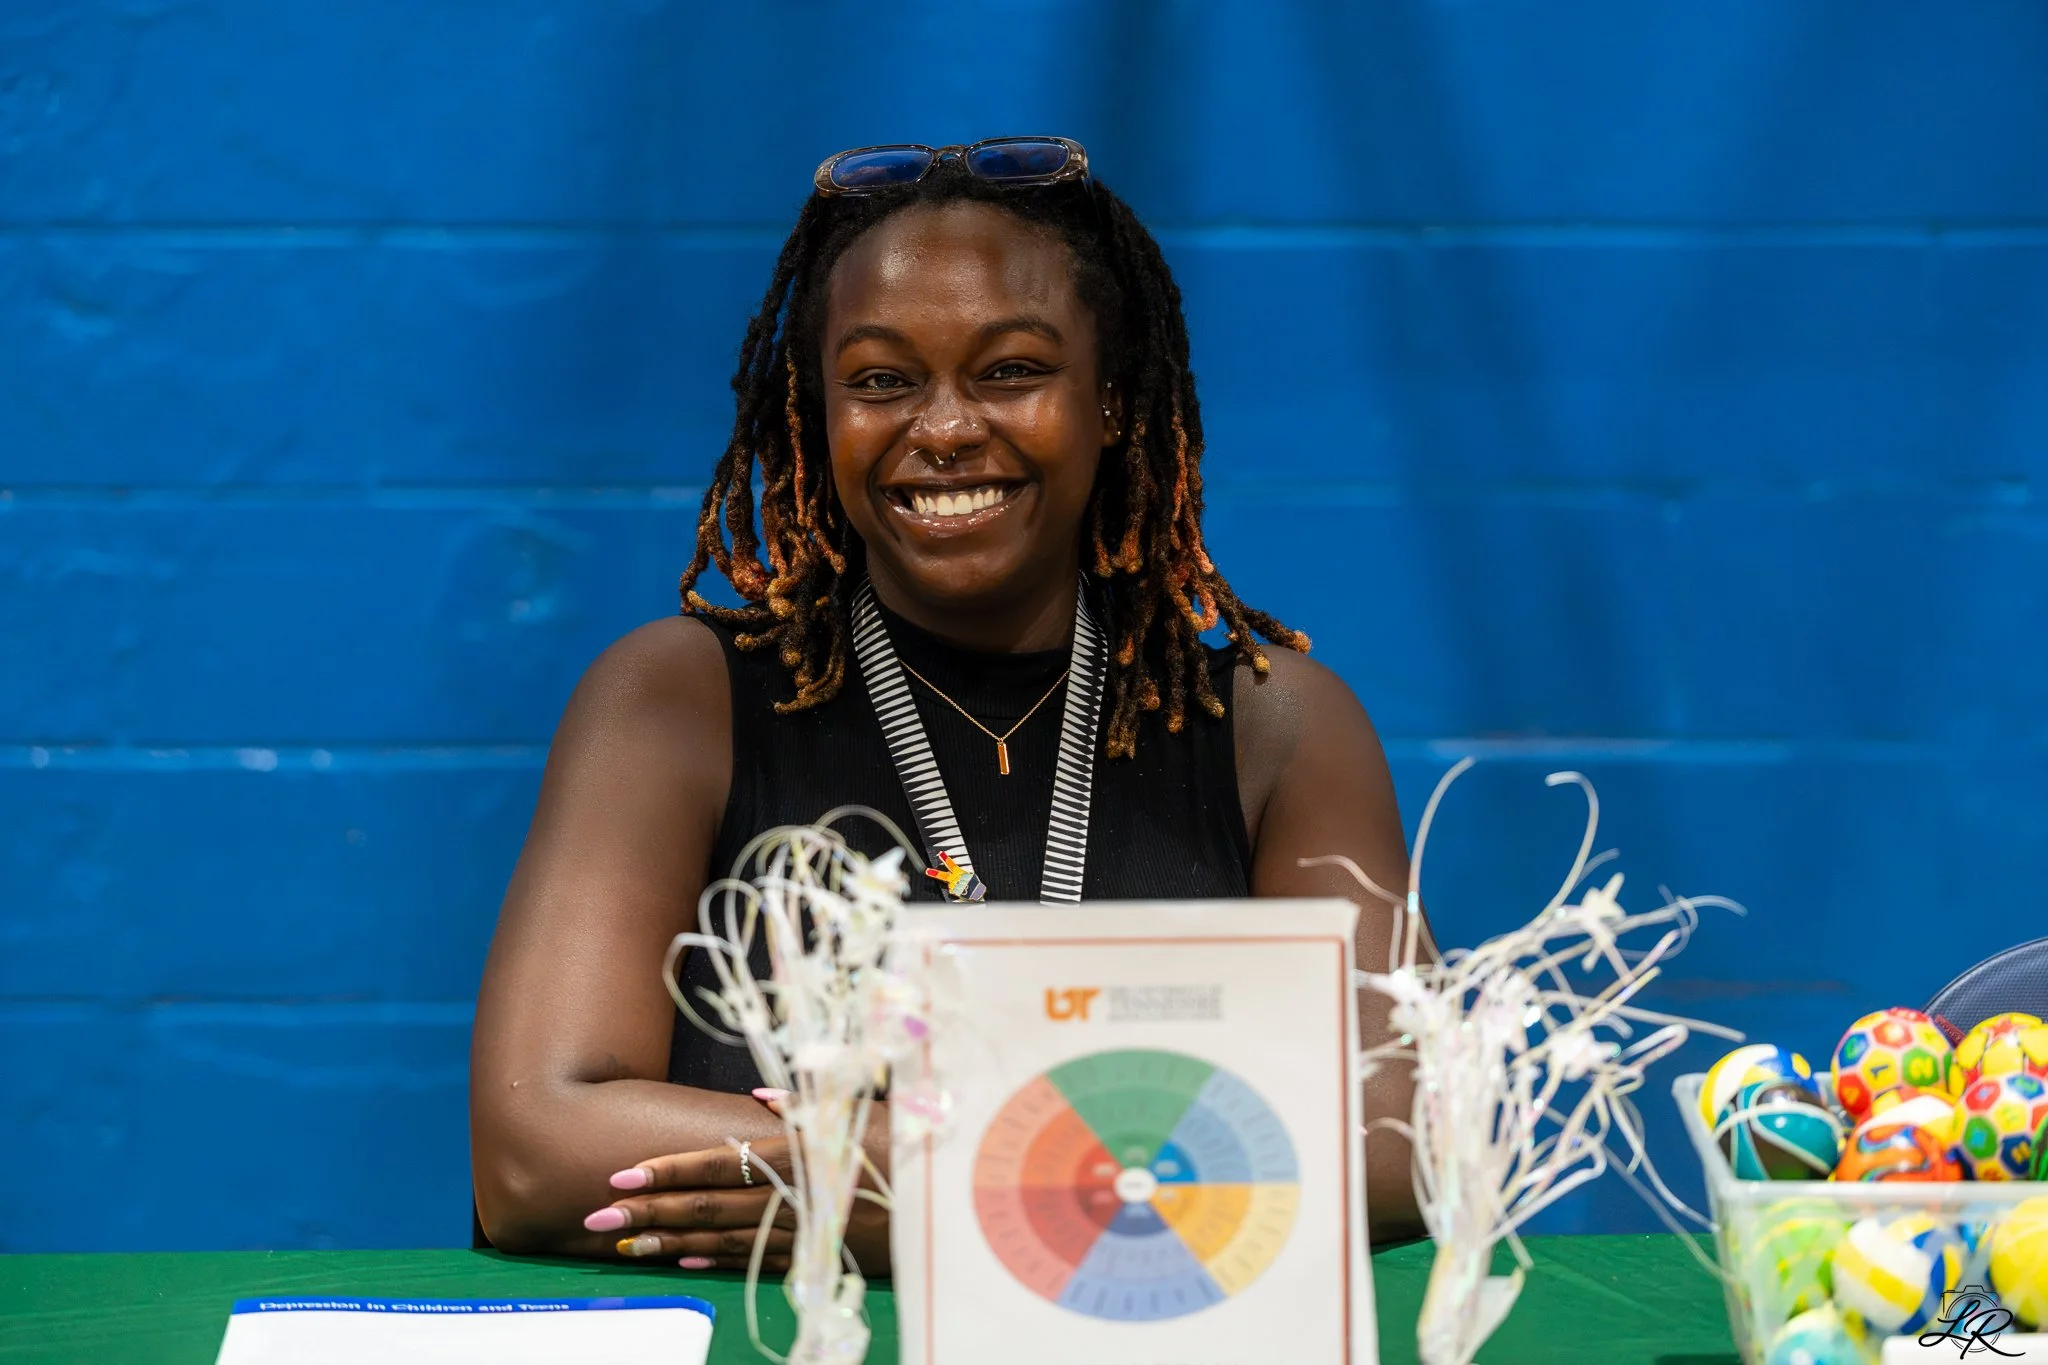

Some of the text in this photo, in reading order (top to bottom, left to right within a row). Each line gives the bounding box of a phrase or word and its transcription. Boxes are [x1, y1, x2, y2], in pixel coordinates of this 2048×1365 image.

[1044, 986, 1101, 1022] UT
[260, 1302, 361, 1311] Depression
[391, 1303, 473, 1312] Children
[478, 1303, 513, 1312] and
[517, 1303, 570, 1311] Teens
